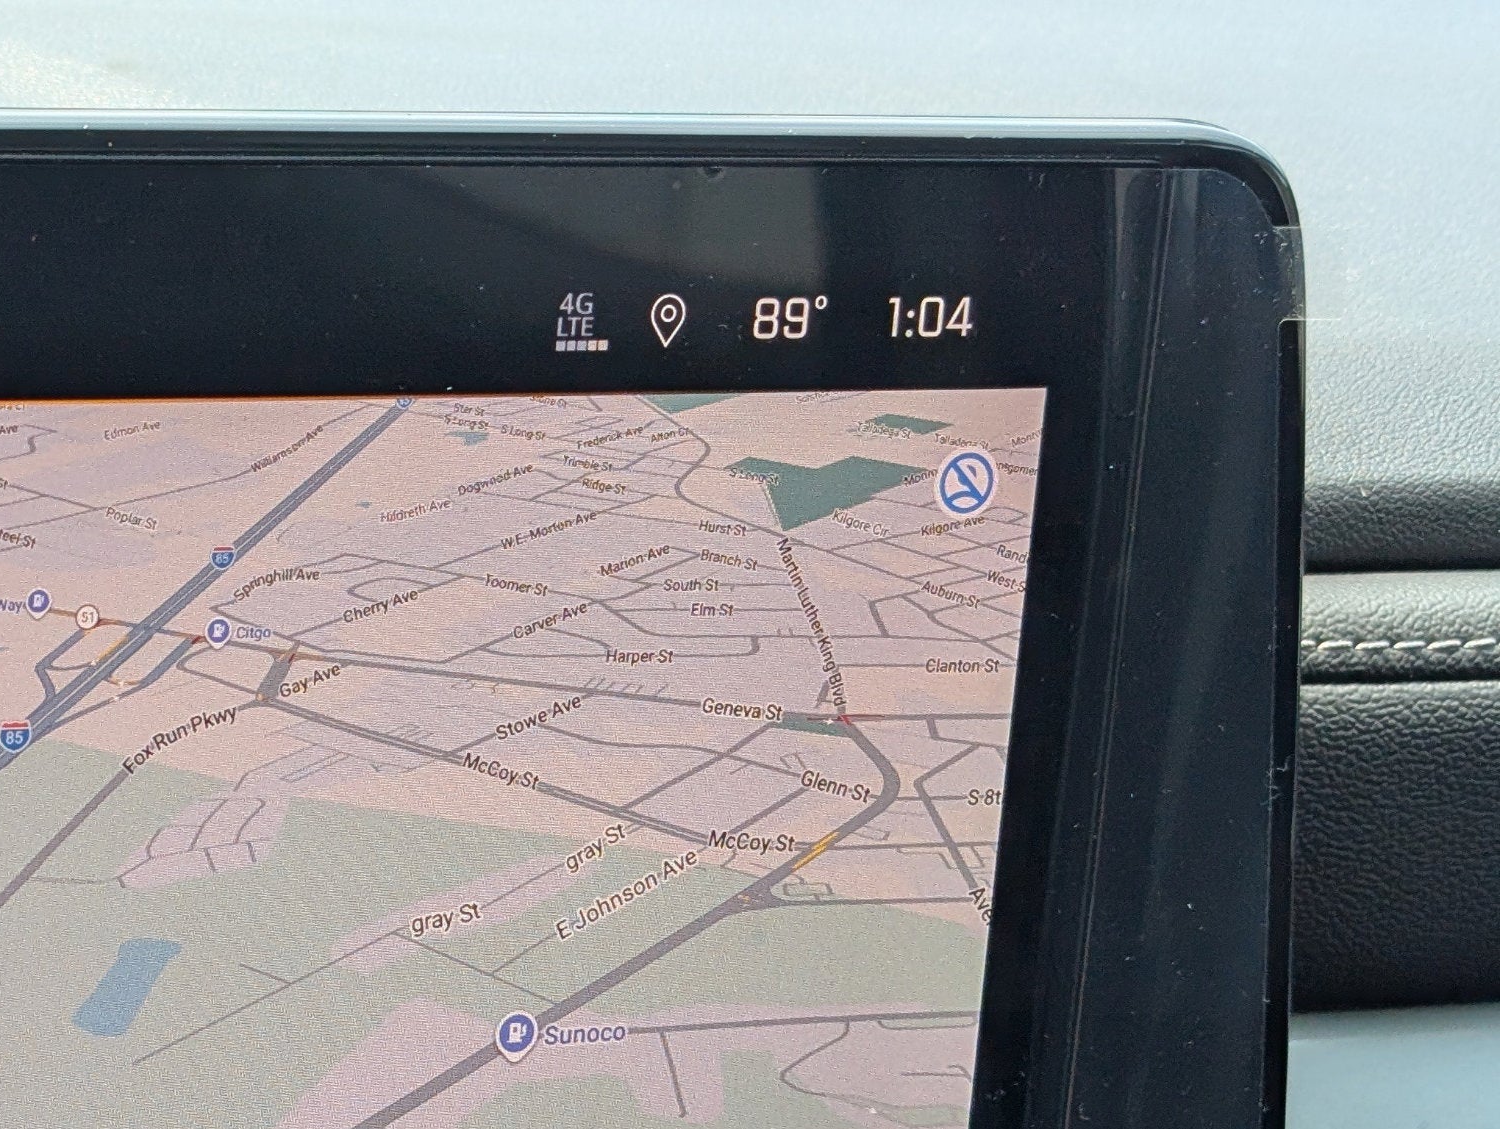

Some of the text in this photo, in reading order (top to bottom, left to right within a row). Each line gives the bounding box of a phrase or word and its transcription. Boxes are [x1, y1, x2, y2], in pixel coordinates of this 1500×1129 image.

[559, 293, 593, 314] 4G
[556, 316, 594, 338] LTE
[752, 295, 828, 340] 89°
[888, 296, 973, 338] 1:04
[0, 425, 19, 436] Ave
[142, 420, 161, 432] Ave
[509, 426, 533, 441] Long
[534, 432, 546, 441] St
[577, 425, 644, 450] Frederick Ave
[250, 424, 324, 473] Williamson Ave
[512, 463, 534, 478] Ave
[563, 455, 614, 473] Trimble St
[581, 477, 626, 495] Ridge St
[105, 505, 158, 531] Poplar St
[429, 499, 451, 513] Ave
[528, 519, 574, 540] Morton
[575, 511, 598, 527] Ave
[698, 520, 747, 537] Hurst St
[832, 510, 890, 537] Kilgore Cir
[920, 515, 986, 537] Kilgore Ave
[21, 534, 36, 549] St
[996, 544, 1029, 563] Rand
[598, 545, 671, 577] Marion Ave
[699, 549, 758, 572] Branch St
[233, 567, 320, 602] Springhill Ave
[484, 573, 549, 597] Toomer St
[663, 578, 719, 592] South St
[987, 569, 1017, 590] West
[343, 590, 419, 623] Cherry Ave
[920, 580, 981, 610] Auburn St
[512, 602, 588, 639] Carver Ave
[690, 602, 734, 617] Elm St
[236, 626, 272, 641] Citgo
[776, 537, 847, 707] Martin Luther King Blvd
[605, 649, 674, 667] Harper St
[925, 658, 1001, 674] Clanton St
[279, 663, 342, 699] Gay Ave
[495, 695, 582, 741] Stowe Ave
[702, 697, 784, 721] Geneva St
[6, 731, 24, 745] 85
[121, 705, 238, 776] Fox Run Pkwy
[462, 752, 540, 791] McCoy St
[801, 769, 871, 803] Glenn St
[967, 789, 980, 806] S
[564, 822, 627, 873] gray St
[708, 830, 796, 856] McCoy St
[556, 849, 699, 941] E Johnson Ave
[410, 901, 482, 938] gray St
[543, 1025, 627, 1046] Sunoco
